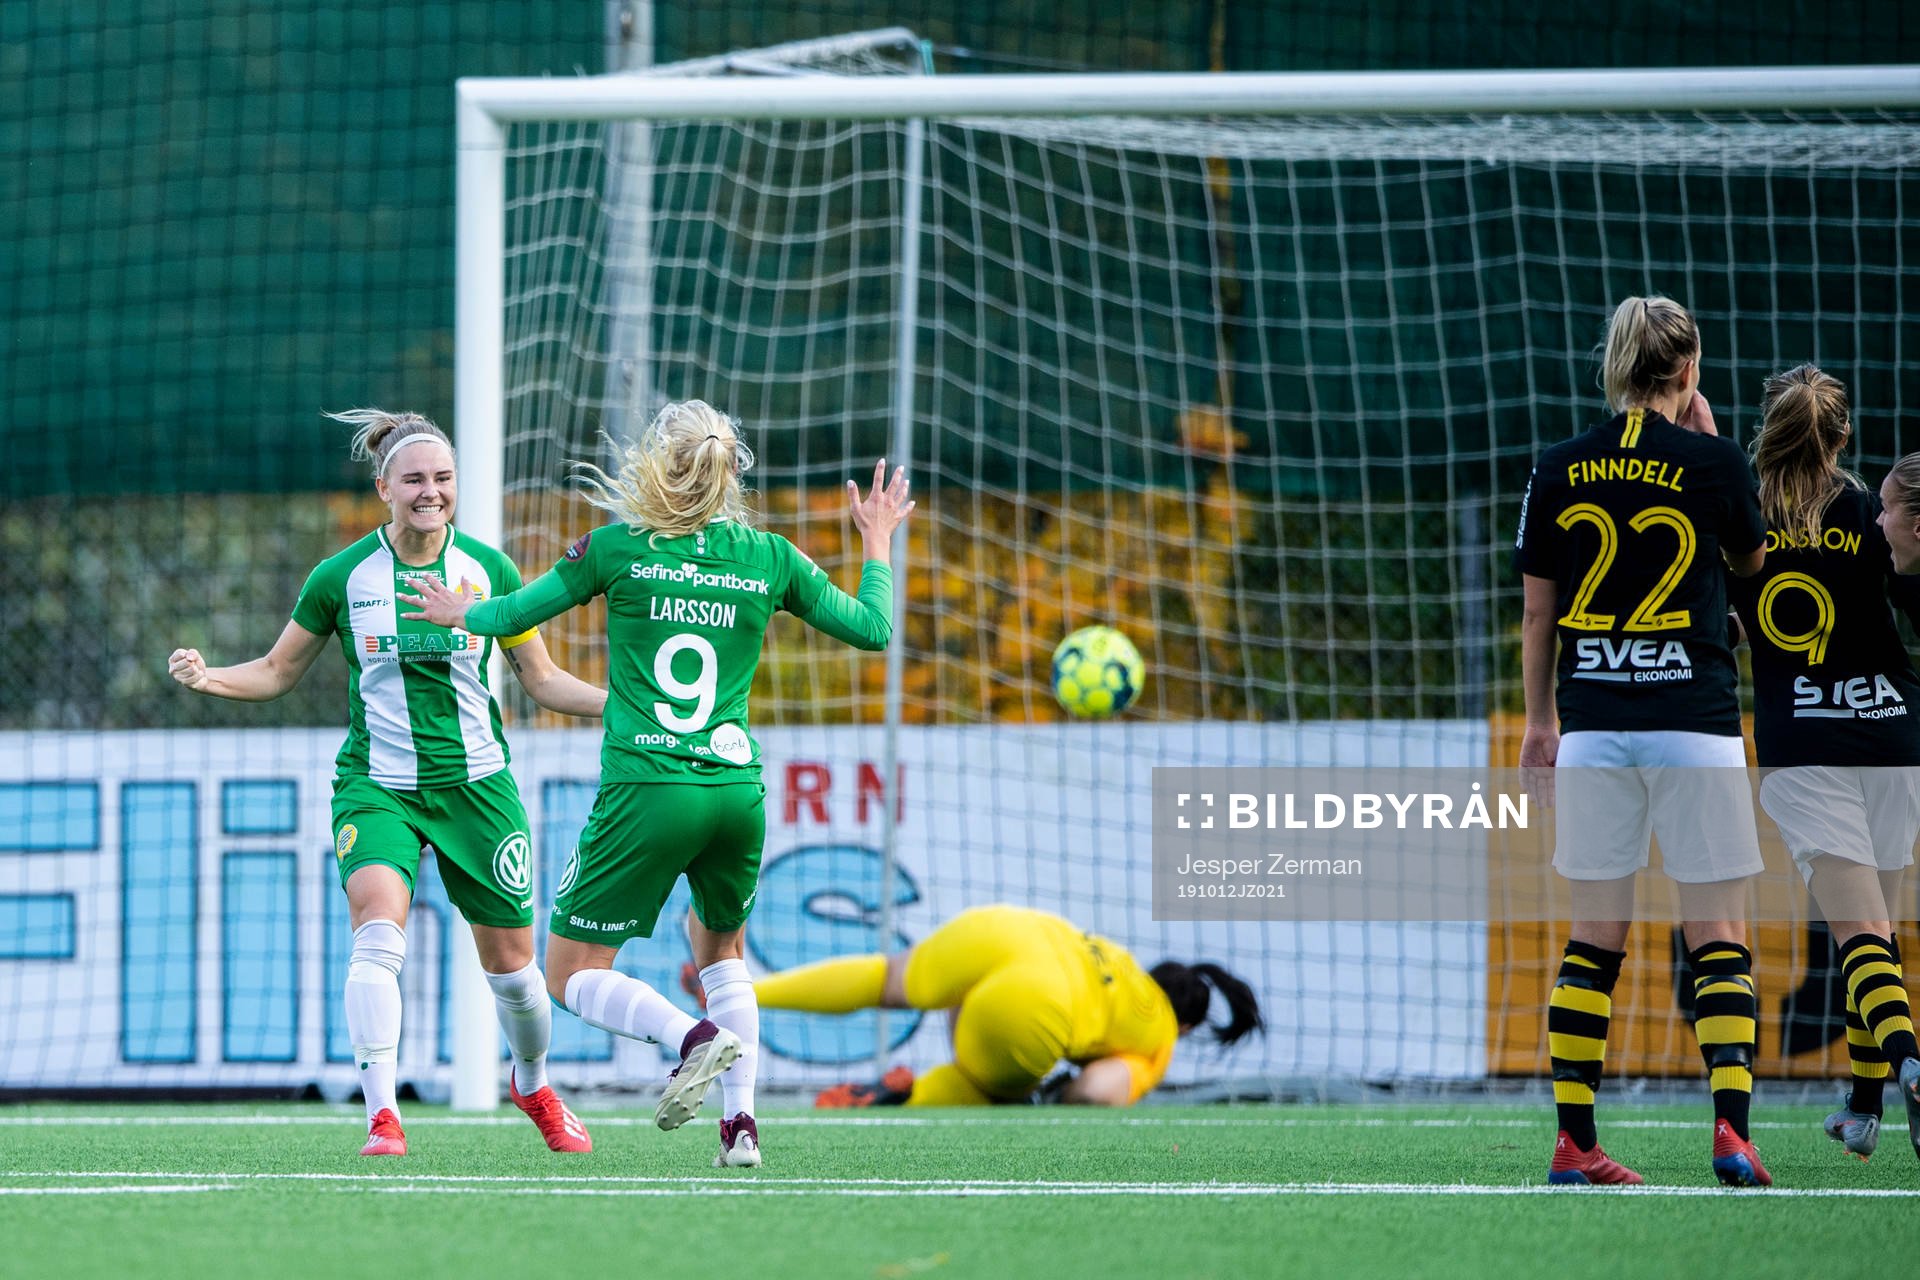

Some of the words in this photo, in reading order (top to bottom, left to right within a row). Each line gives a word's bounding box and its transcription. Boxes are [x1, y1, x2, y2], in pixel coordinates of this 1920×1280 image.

[1567, 458, 1684, 492] FINNDELL
[1766, 527, 1862, 556] ONSSON
[630, 563, 684, 583] Sefina
[692, 571, 769, 596] pantbank
[1555, 502, 1697, 632] 22
[352, 599, 382, 609] CRAFT
[650, 596, 735, 629] LARSSON
[1757, 571, 1835, 666] 9
[377, 634, 468, 653] PEAB
[1576, 638, 1691, 670] SVEA
[653, 633, 718, 734] 9
[1634, 668, 1692, 682] EKONOMI
[569, 915, 598, 930] SILJA
[602, 922, 626, 931] LINE
